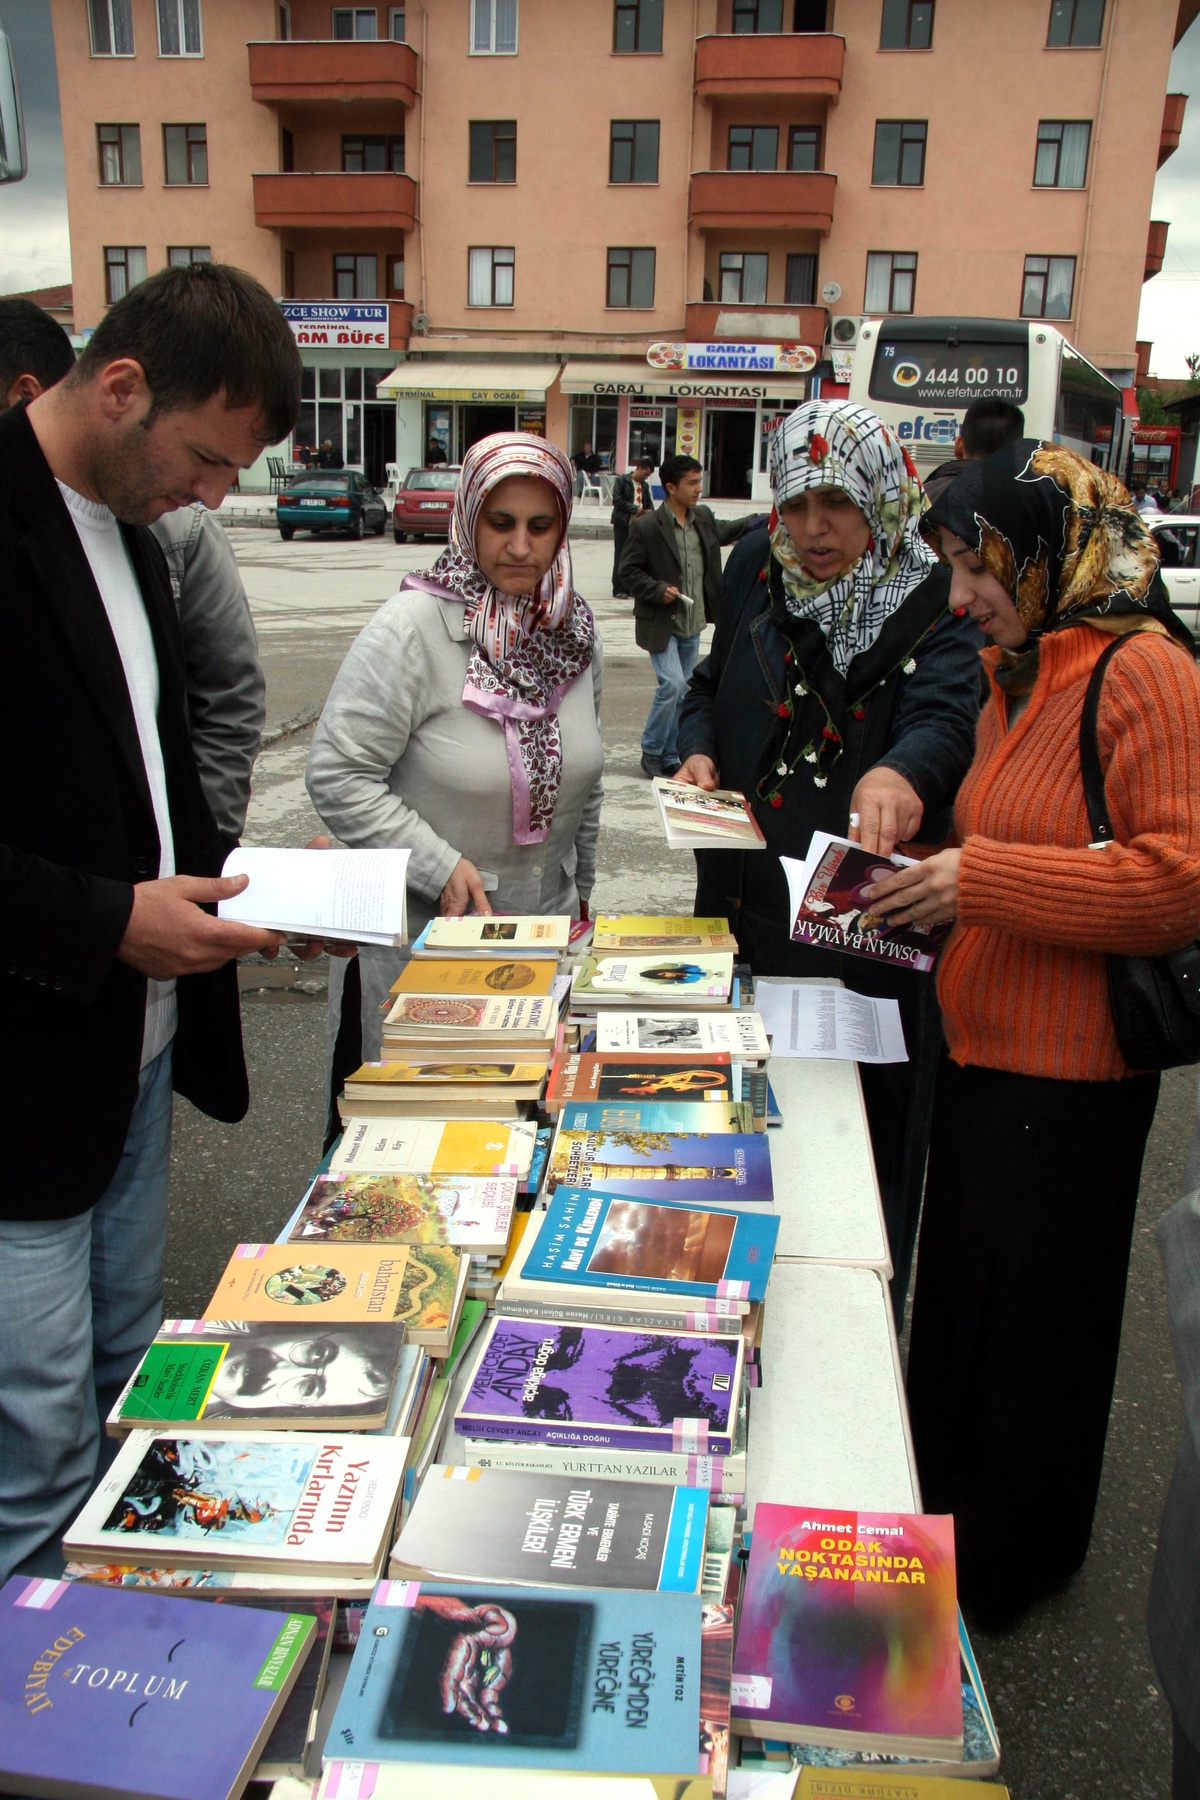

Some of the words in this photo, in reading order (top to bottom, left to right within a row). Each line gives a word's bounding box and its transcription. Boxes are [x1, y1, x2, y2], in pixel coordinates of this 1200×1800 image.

[282, 307, 308, 317] ZCE
[311, 308, 350, 317] SHOW
[354, 308, 383, 318] TUR
[294, 332, 328, 344] AM
[337, 330, 385, 344] BÜFE
[706, 344, 756, 354] GARAJ
[884, 347, 895, 357] 75
[688, 354, 775, 370] LOKANTASI
[925, 368, 959, 384] 444
[965, 368, 989, 384] 00
[996, 368, 1018, 385] 10
[472, 391, 489, 400] ÇAY
[493, 391, 520, 400] OCAĞI
[593, 383, 644, 395] GARAJ
[669, 385, 767, 398] LOKANTASI
[918, 386, 1023, 398] www.efetur.com.tr
[631, 408, 662, 417] DÖNER
[794, 918, 866, 949] BAYMAK
[866, 941, 922, 963] OSMAN
[344, 1140, 361, 1164] Mahmut
[499, 1181, 515, 1204] ÇOCUK
[542, 1233, 565, 1268] HAŞİM
[558, 1193, 580, 1230] ŞAHİN
[366, 1258, 401, 1314] baharistan
[501, 1305, 540, 1316] Kahraman
[542, 1308, 563, 1318] Bülent
[566, 1310, 588, 1320] Hasan
[629, 1316, 684, 1327] BEYAZLAR
[532, 1338, 555, 1366] doğru
[194, 1358, 214, 1385] ÖZKAN
[470, 1365, 494, 1399] MELİH
[483, 1332, 509, 1367] CEVDET
[490, 1333, 540, 1403] ANDAY
[522, 1359, 545, 1402] açıklığa
[185, 1385, 203, 1407] MERT
[462, 1423, 485, 1434] MELİH
[486, 1426, 516, 1436] CEVDET
[546, 1431, 582, 1443] AÇIKLIĞA
[582, 1432, 611, 1444] DOĞRU
[562, 1461, 622, 1475] YURTTAN
[625, 1463, 677, 1477] YAZILAR
[286, 1445, 344, 1546] Kırlarında
[325, 1460, 370, 1533] Yazının
[563, 1489, 593, 1521] TÜRK
[521, 1498, 561, 1555] İLİŞKİLERİ
[587, 1526, 600, 1537] VE
[801, 1520, 852, 1533] Ahmet
[856, 1524, 904, 1536] Cemal
[550, 1521, 584, 1569] ERMENİ
[820, 1538, 882, 1553] ODAK
[779, 1548, 923, 1570] NOKTASINDA
[776, 1563, 926, 1584] YAŞANANLAR
[24, 1626, 87, 1716] EDEBİYAT
[591, 1640, 620, 1714] YÜREĞİNE
[675, 1656, 686, 1682] METİN
[70, 1664, 190, 1700] TOPLUM
[625, 1631, 654, 1729] YÜREĞİMDEN
[674, 1683, 684, 1702] TOZ
[809, 1783, 858, 1795] DİZİSİ
[860, 1786, 918, 1798] ATATÜRK
